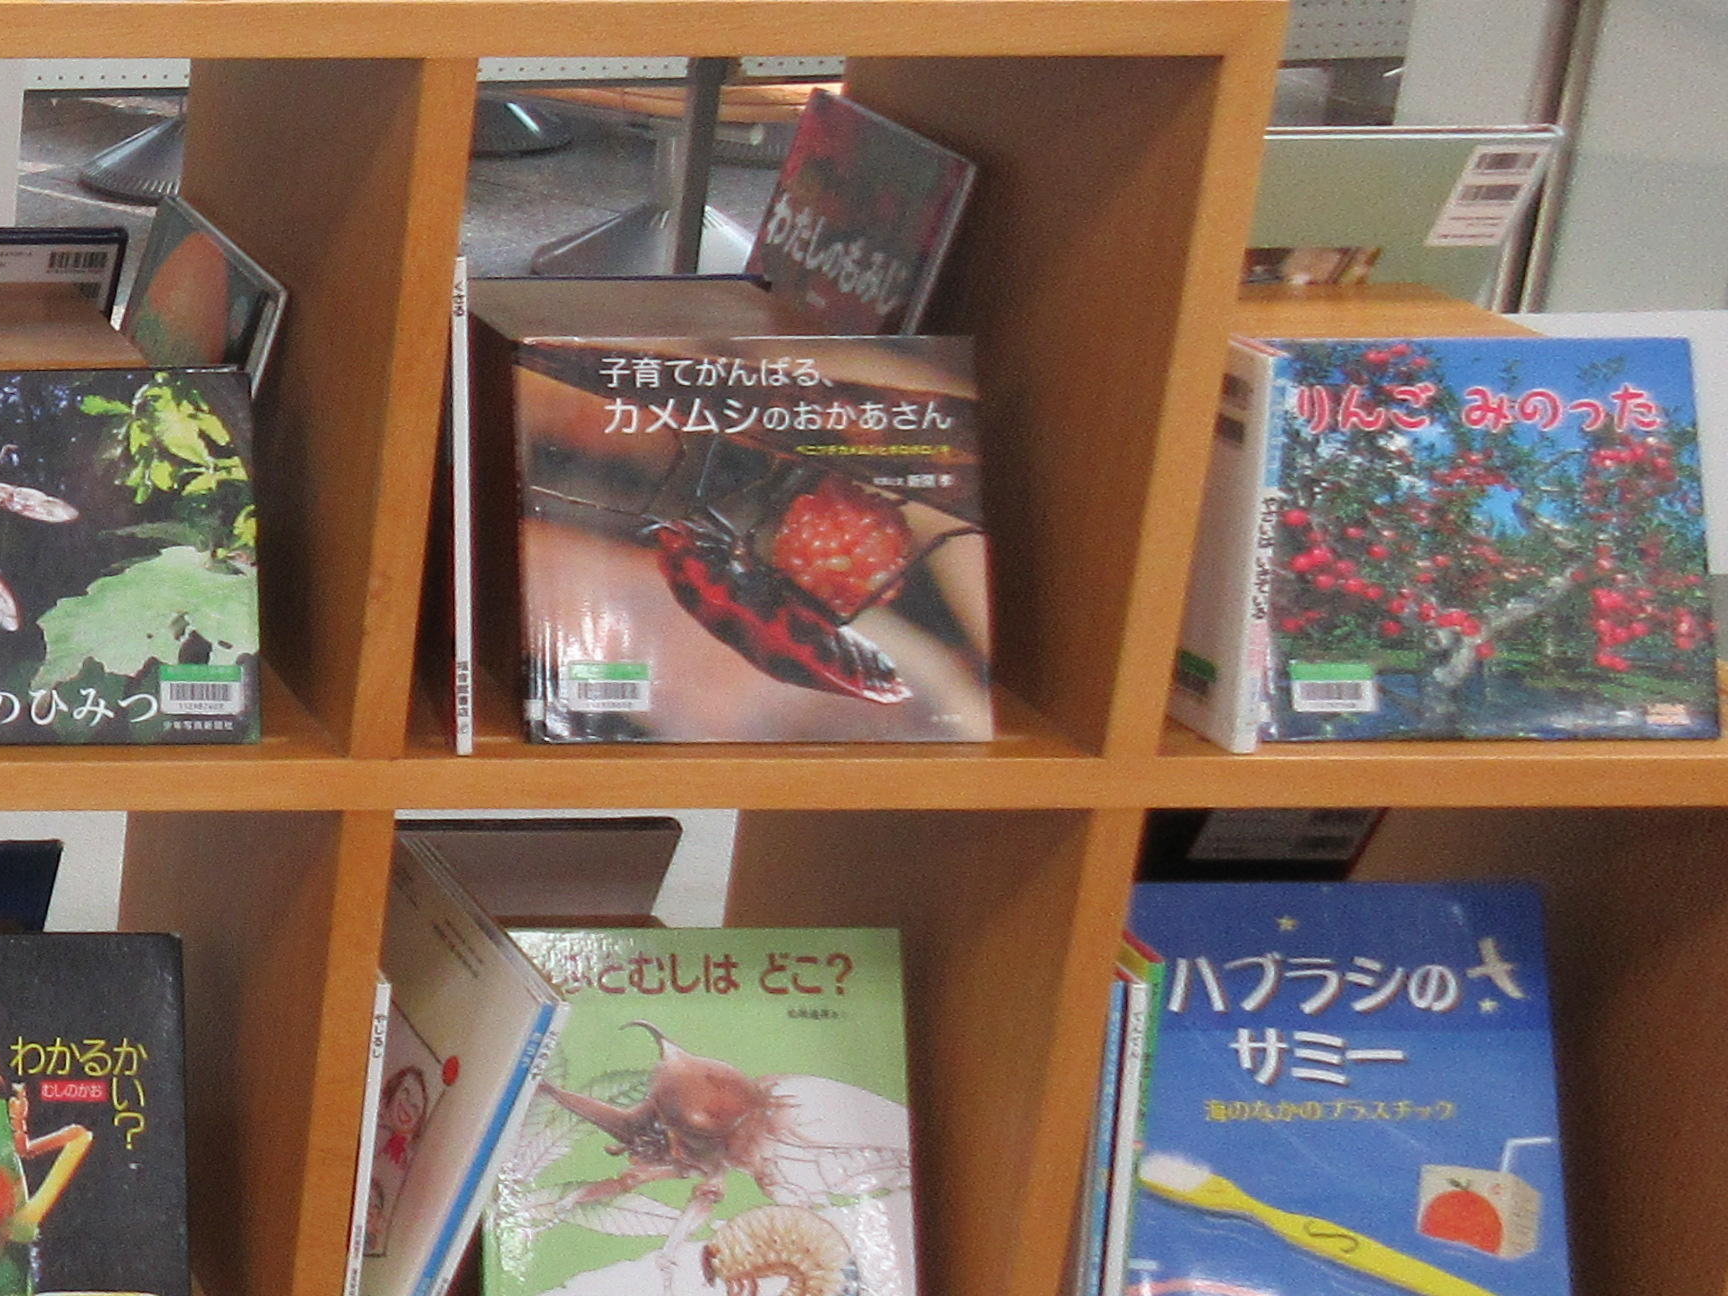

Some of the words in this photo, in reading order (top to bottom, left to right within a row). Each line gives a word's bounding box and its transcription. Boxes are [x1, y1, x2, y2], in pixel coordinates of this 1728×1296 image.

[599, 358, 835, 390] 子育てがんばる、
[603, 400, 952, 435] カメムシのおかあさん
[1296, 383, 1437, 433] りんご
[1462, 384, 1662, 433] みのった
[758, 952, 854, 995] どこ?
[1167, 954, 1461, 1014] ハブラシの
[10, 1036, 148, 1077] わかるか
[1228, 1027, 1406, 1085] サミー
[41, 1081, 103, 1099] むしのかお
[1203, 1099, 1457, 1122] 海のなかのプラスチック
